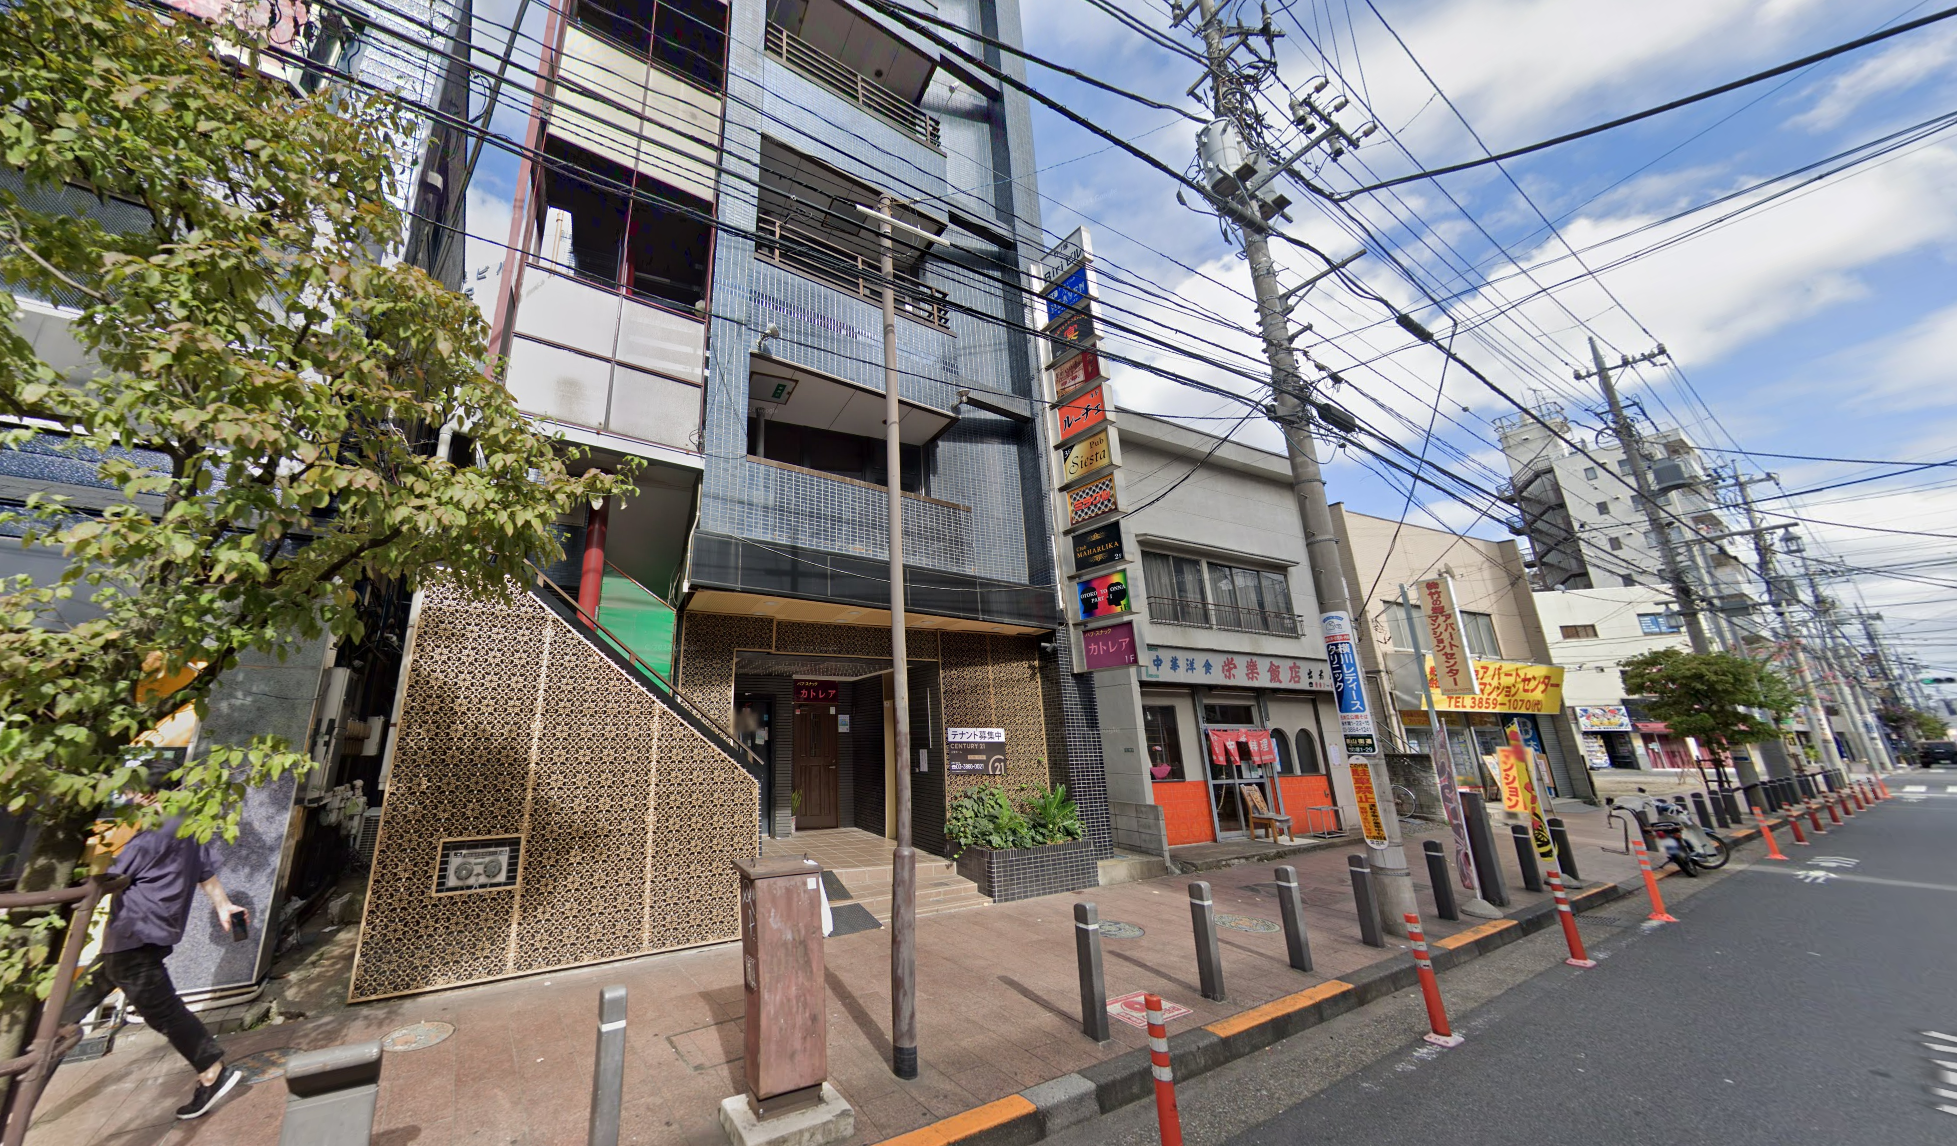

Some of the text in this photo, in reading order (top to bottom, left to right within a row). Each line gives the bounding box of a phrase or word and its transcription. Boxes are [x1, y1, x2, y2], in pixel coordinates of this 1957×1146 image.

[1063, 403, 1101, 432] ルーチェ
[1089, 437, 1104, 450] Pub
[1068, 448, 1107, 475] Siesta
[1073, 490, 1111, 511] ミラクル
[1076, 540, 1119, 559] MAHARLIKA
[1080, 590, 1098, 600] OTOKO
[1109, 583, 1126, 593] ONNA
[1090, 596, 1105, 604] PART
[1427, 614, 1446, 653] マンション
[1439, 611, 1460, 653] アパート
[1088, 638, 1130, 655] カトレア
[1124, 654, 1135, 663] 1F
[1152, 654, 1214, 675] 中華洋食
[1327, 644, 1344, 692] クリニック
[1441, 650, 1460, 687] センター
[1336, 642, 1364, 711] 横川レディース
[1480, 664, 1560, 695] アパート センター
[800, 688, 836, 699] カトレア
[1479, 682, 1520, 698] マンション
[1447, 695, 1467, 709] TEL
[951, 730, 1002, 741] テナント募集中
[1350, 769, 1377, 804] 駐車禁止
